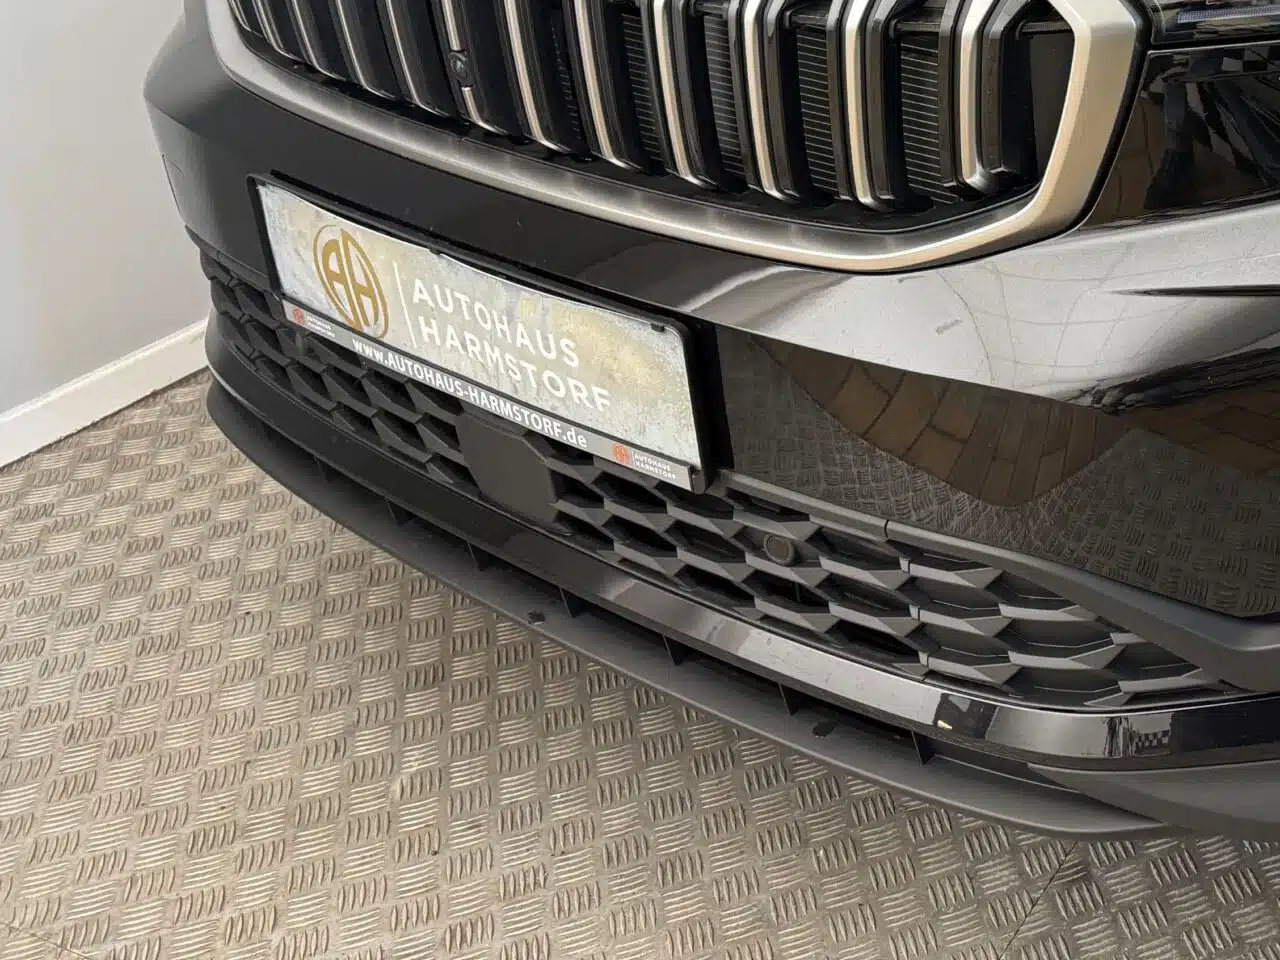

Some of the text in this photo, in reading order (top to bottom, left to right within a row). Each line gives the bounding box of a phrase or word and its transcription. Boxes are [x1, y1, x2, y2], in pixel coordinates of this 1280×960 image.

[412, 277, 580, 368] AUTOHAUS
[418, 315, 611, 412] HARMSTORF
[351, 338, 588, 449] www.AUTOHAUS-HARMSTORF.de
